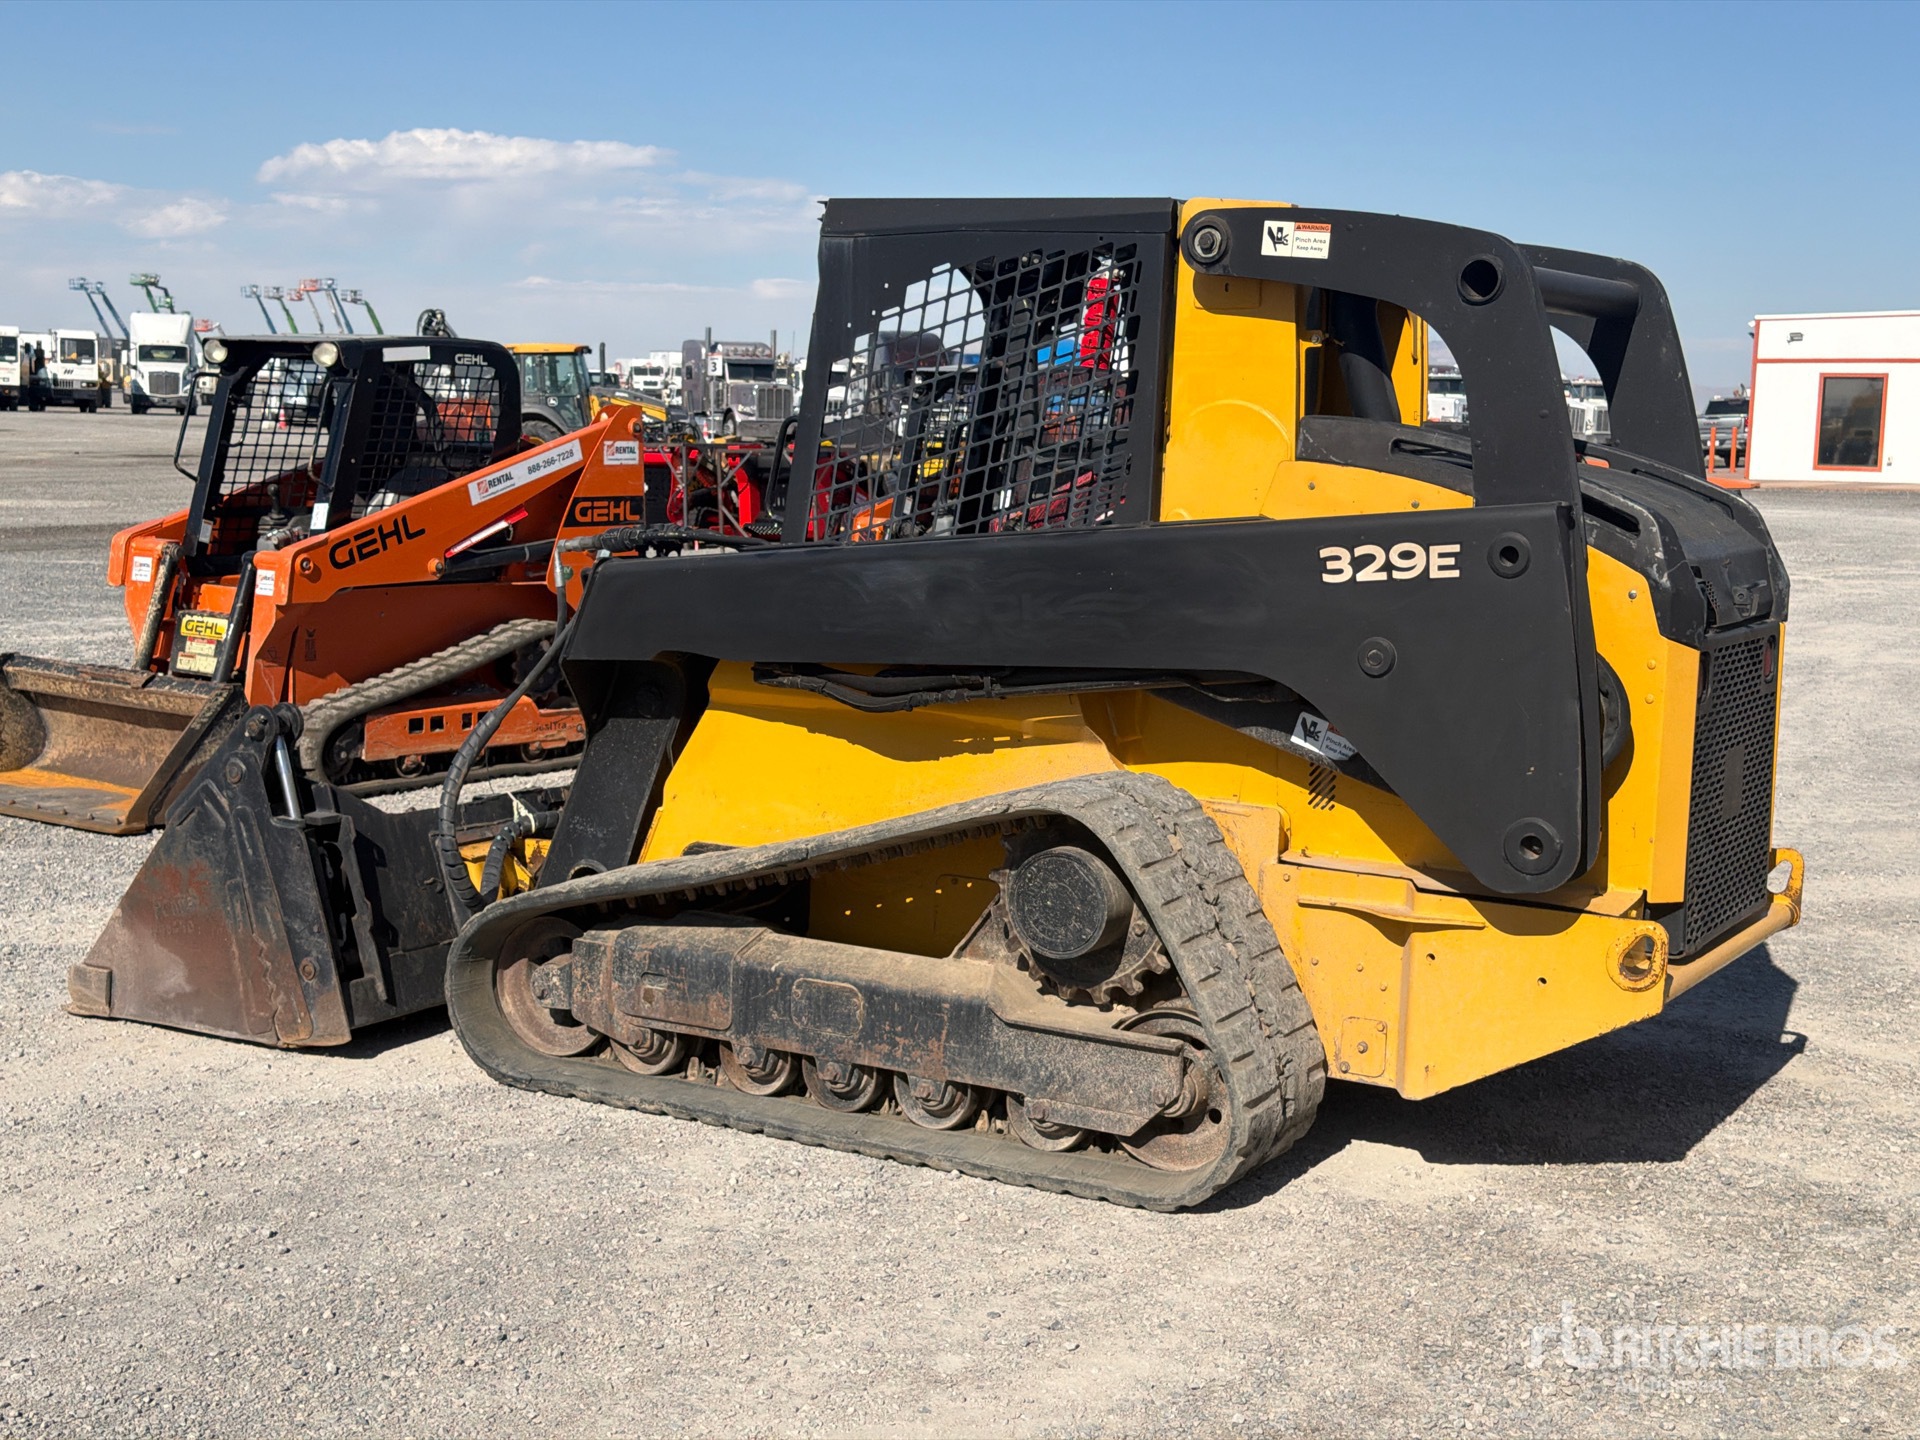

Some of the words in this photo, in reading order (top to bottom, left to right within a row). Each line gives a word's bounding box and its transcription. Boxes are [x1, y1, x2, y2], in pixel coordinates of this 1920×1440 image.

[455, 353, 488, 366] GEHL
[711, 361, 717, 373] 3
[615, 446, 636, 455] RENTAL
[487, 472, 514, 489] RENTAL
[527, 449, 575, 475] 888-266-7228
[574, 500, 641, 523] GEHL
[329, 514, 426, 569] GEHL
[1319, 542, 1461, 583] 329E
[184, 619, 223, 636] GEHL
[1326, 736, 1342, 747] Pinch
